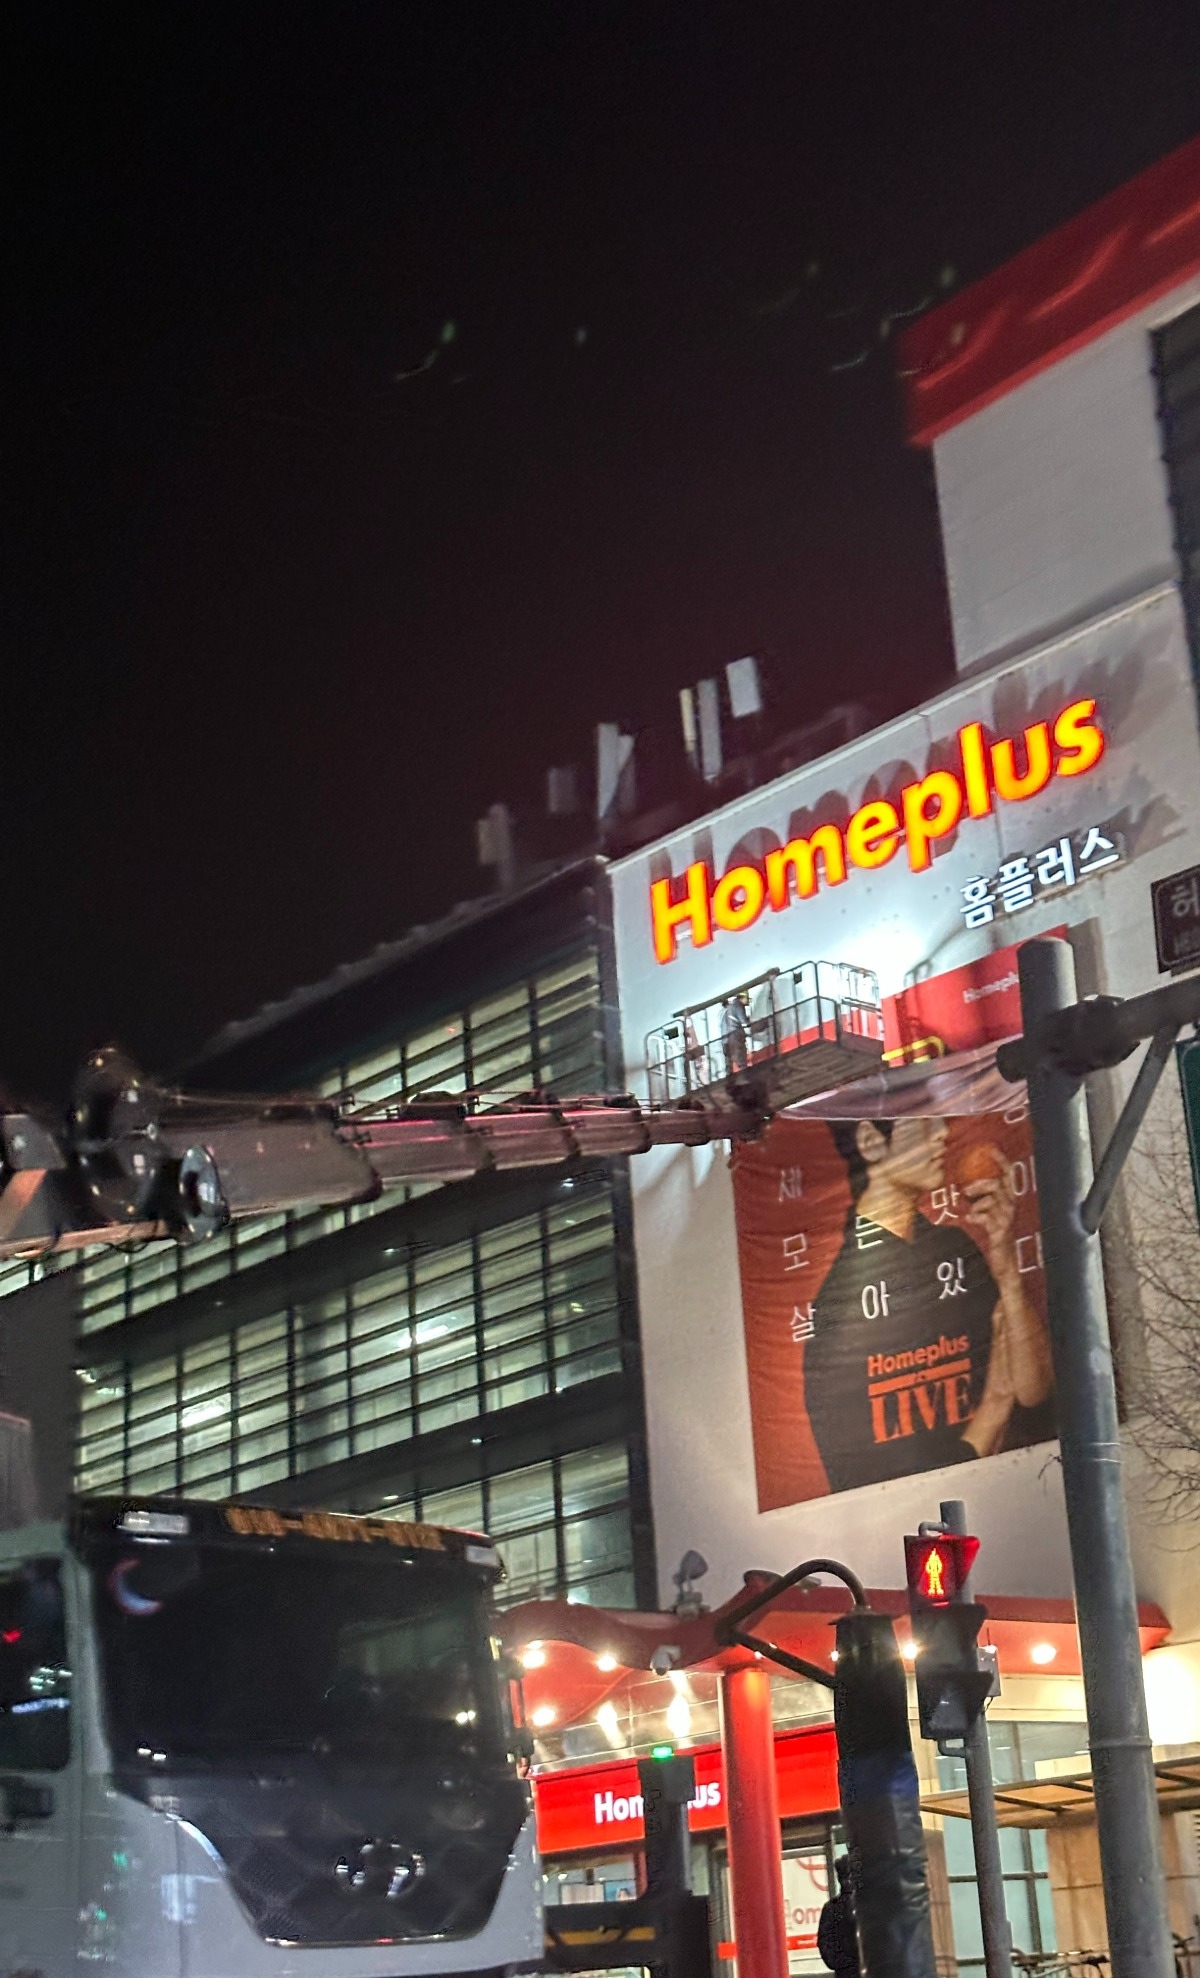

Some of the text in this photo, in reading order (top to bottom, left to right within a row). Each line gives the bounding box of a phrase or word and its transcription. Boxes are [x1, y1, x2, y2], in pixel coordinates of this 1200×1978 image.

[650, 699, 1105, 965] Homeplus
[959, 826, 1120, 930] 홈플러스
[867, 1335, 971, 1377] Homeplus
[870, 1373, 977, 1444] LIVE
